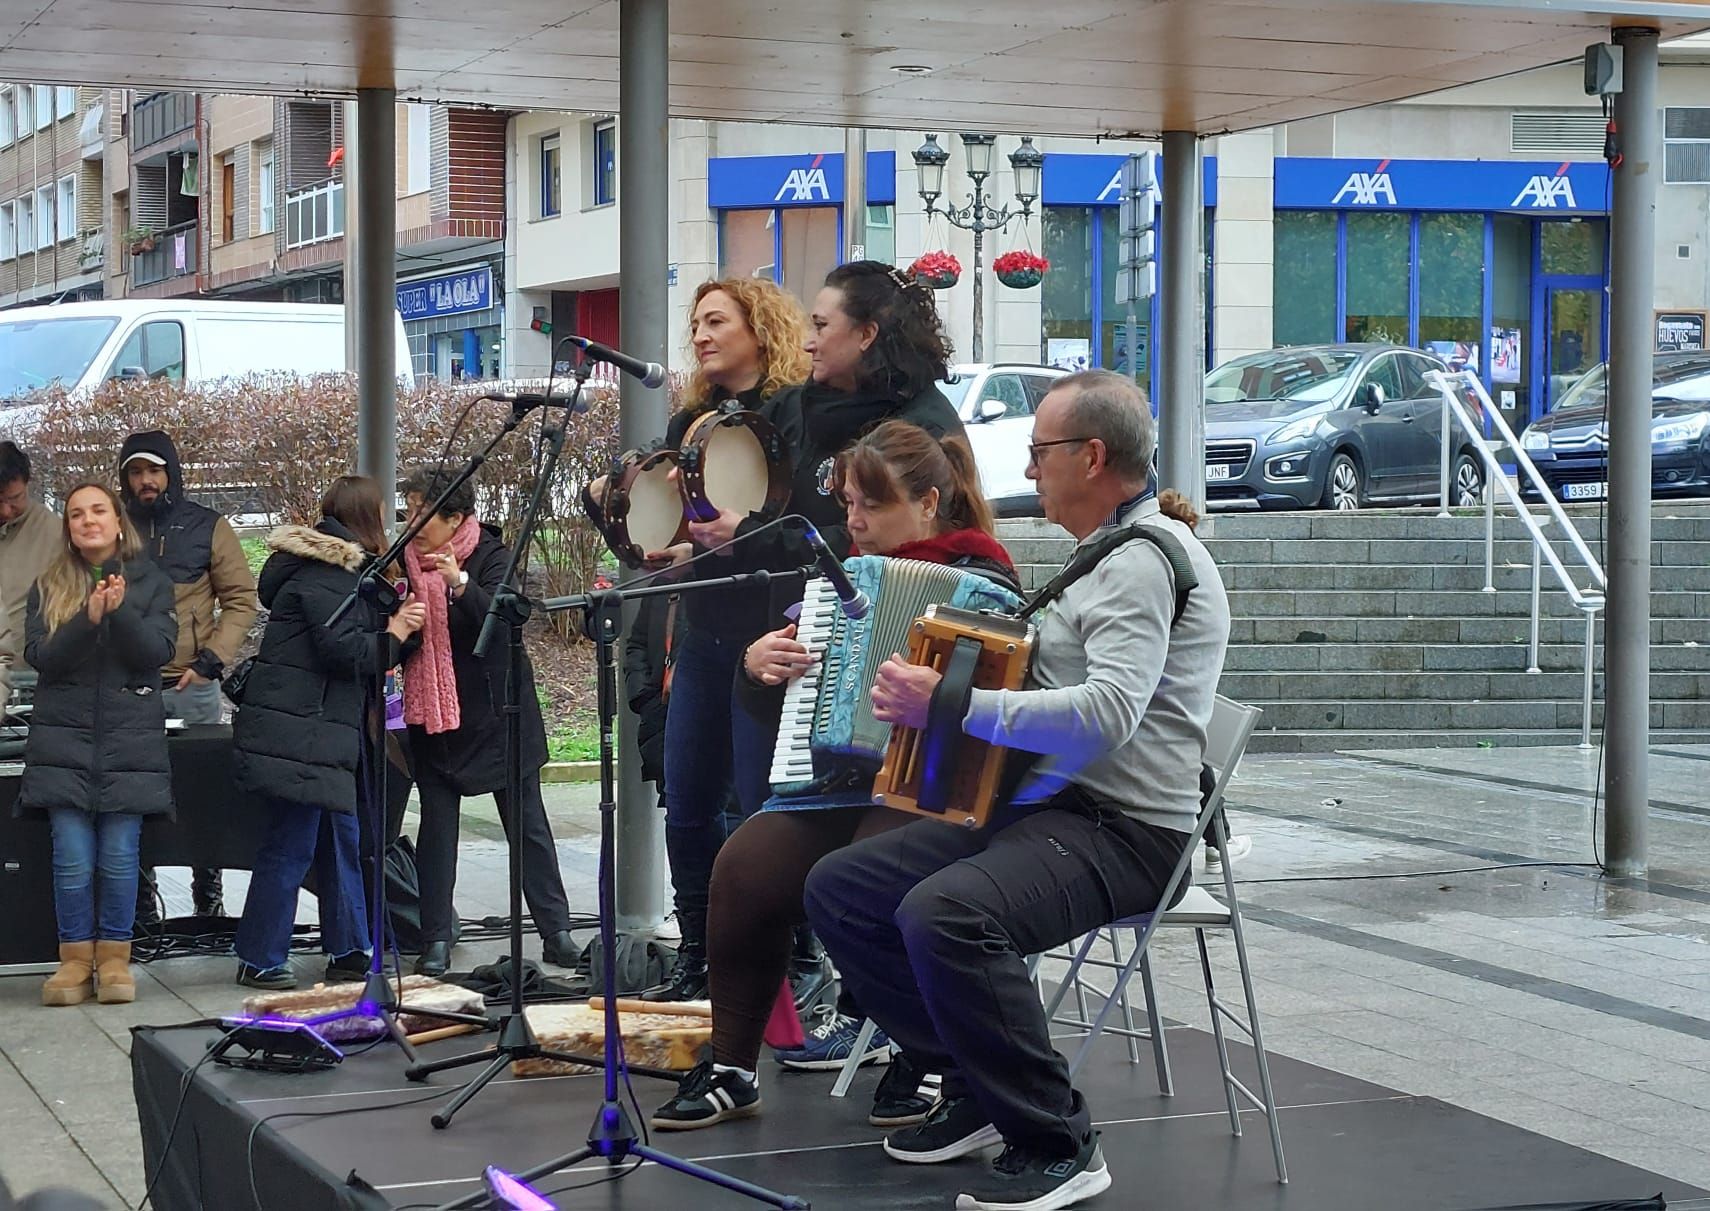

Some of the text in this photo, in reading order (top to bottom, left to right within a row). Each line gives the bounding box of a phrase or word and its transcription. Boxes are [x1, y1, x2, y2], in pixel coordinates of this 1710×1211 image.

[775, 168, 830, 200] AXA
[1331, 173, 1398, 205] AXA
[1511, 176, 1577, 207] AXA
[396, 286, 428, 315] SUPER
[1658, 328, 1689, 343] HUEVOS
[1208, 466, 1227, 478] JNF
[1571, 485, 1597, 497] 3359
